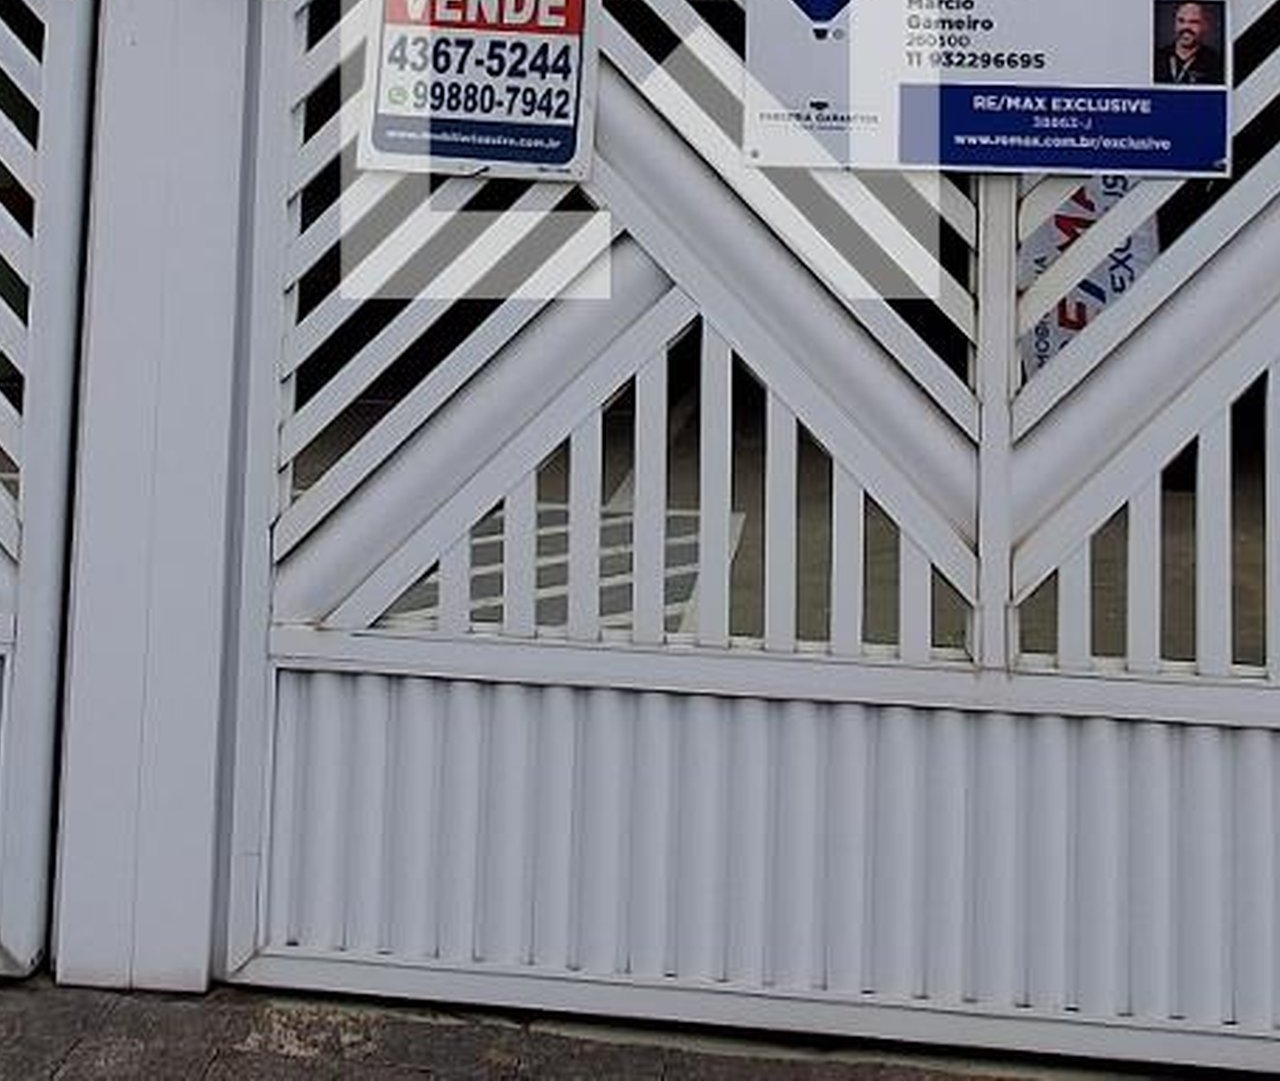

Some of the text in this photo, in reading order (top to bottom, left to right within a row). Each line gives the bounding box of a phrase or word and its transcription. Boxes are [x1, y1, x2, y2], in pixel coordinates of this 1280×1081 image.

[388, 36, 572, 80] 4367-5244
[907, 52, 1045, 69] 11 932296695
[413, 81, 571, 118] 99880-7942
[973, 95, 1152, 114] RE/MAX EXCLUSIVE
